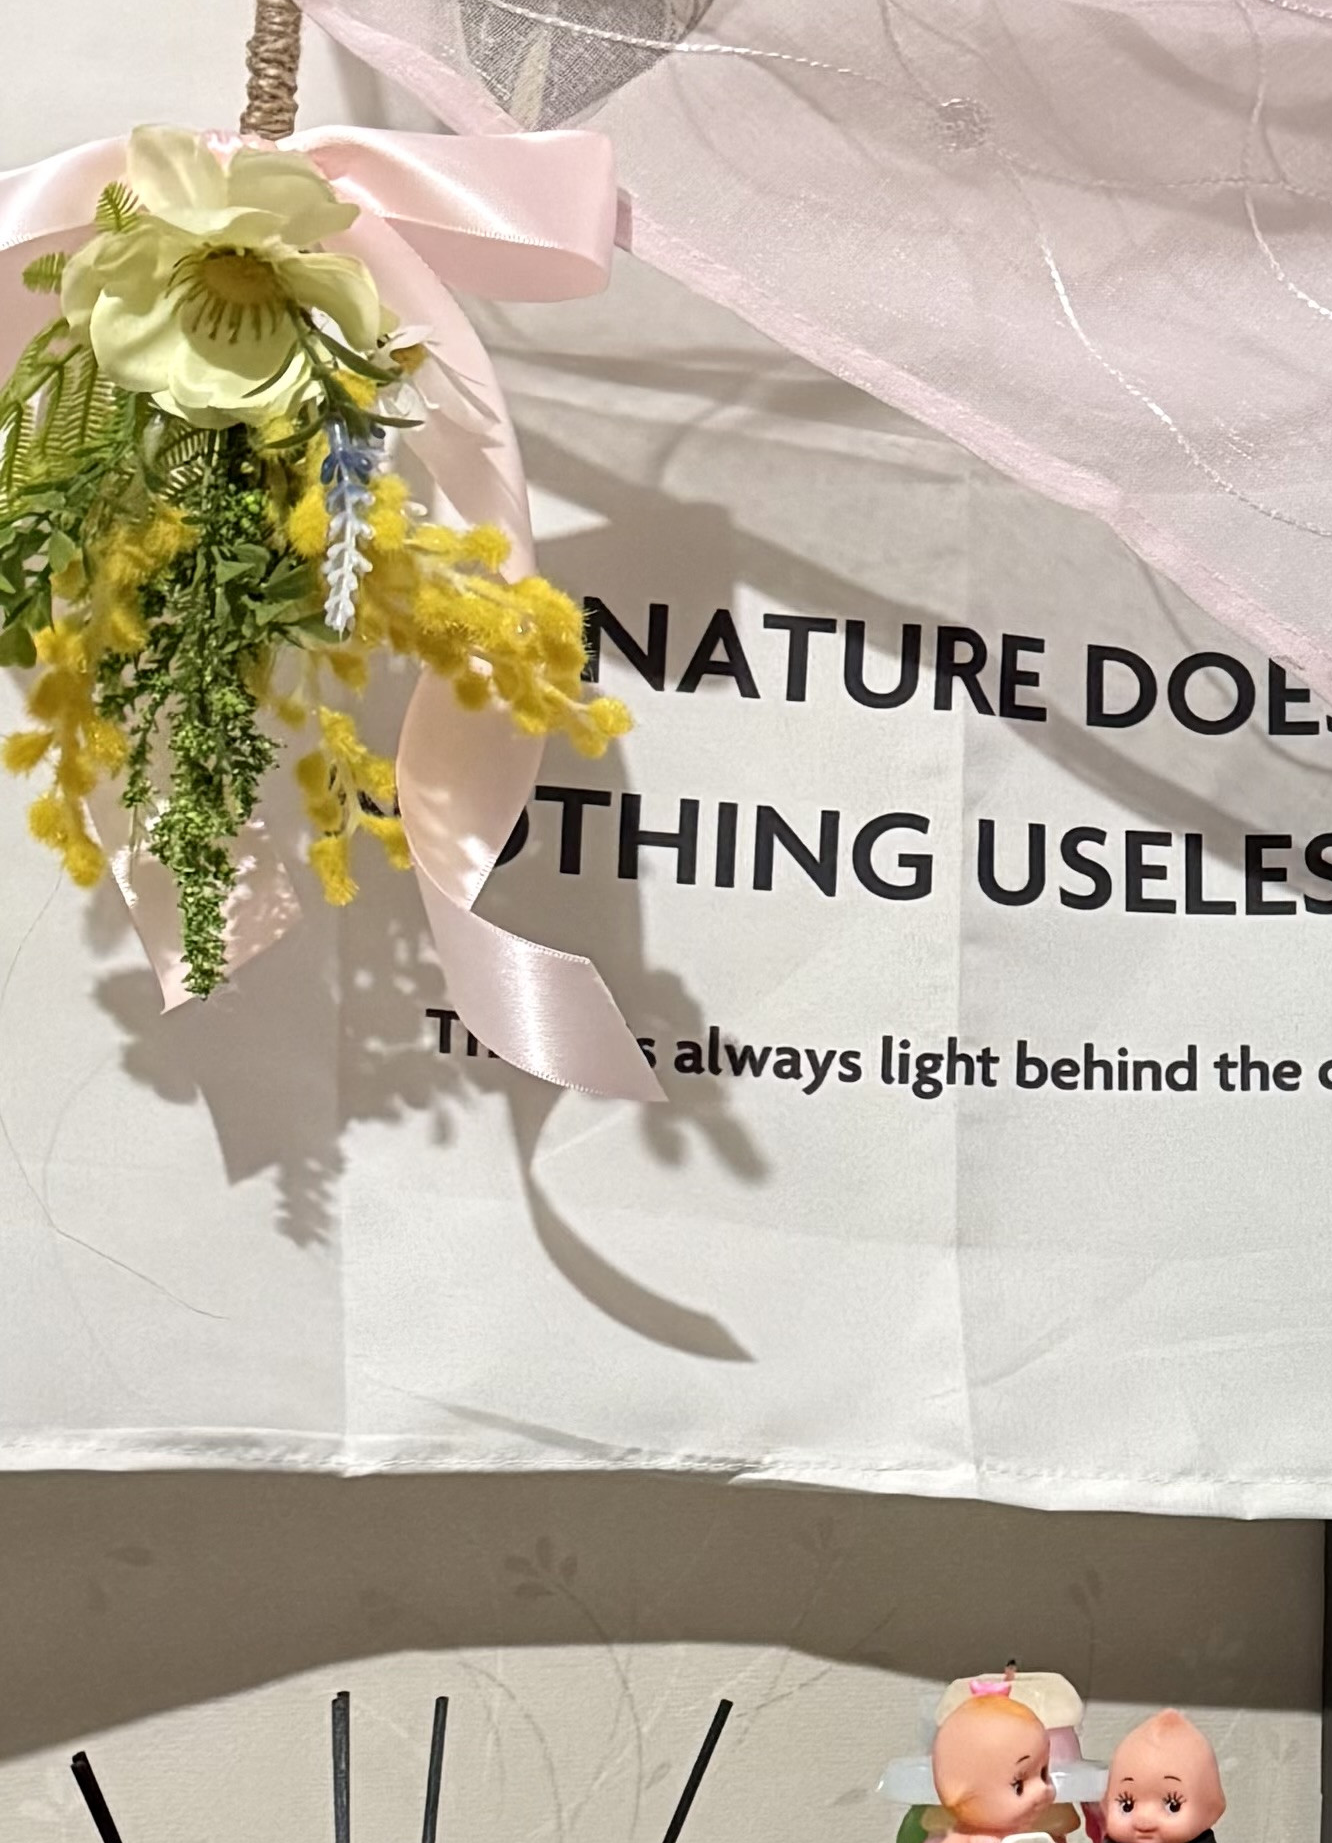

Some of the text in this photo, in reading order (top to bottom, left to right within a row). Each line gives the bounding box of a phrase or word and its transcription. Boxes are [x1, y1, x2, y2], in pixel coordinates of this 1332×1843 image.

[580, 596, 1047, 722] NATURE
[326, 764, 933, 901] THING
[673, 1026, 861, 1095] always
[881, 1036, 1000, 1099] light
[1016, 1040, 1197, 1091] behind
[1214, 1045, 1302, 1091] the
